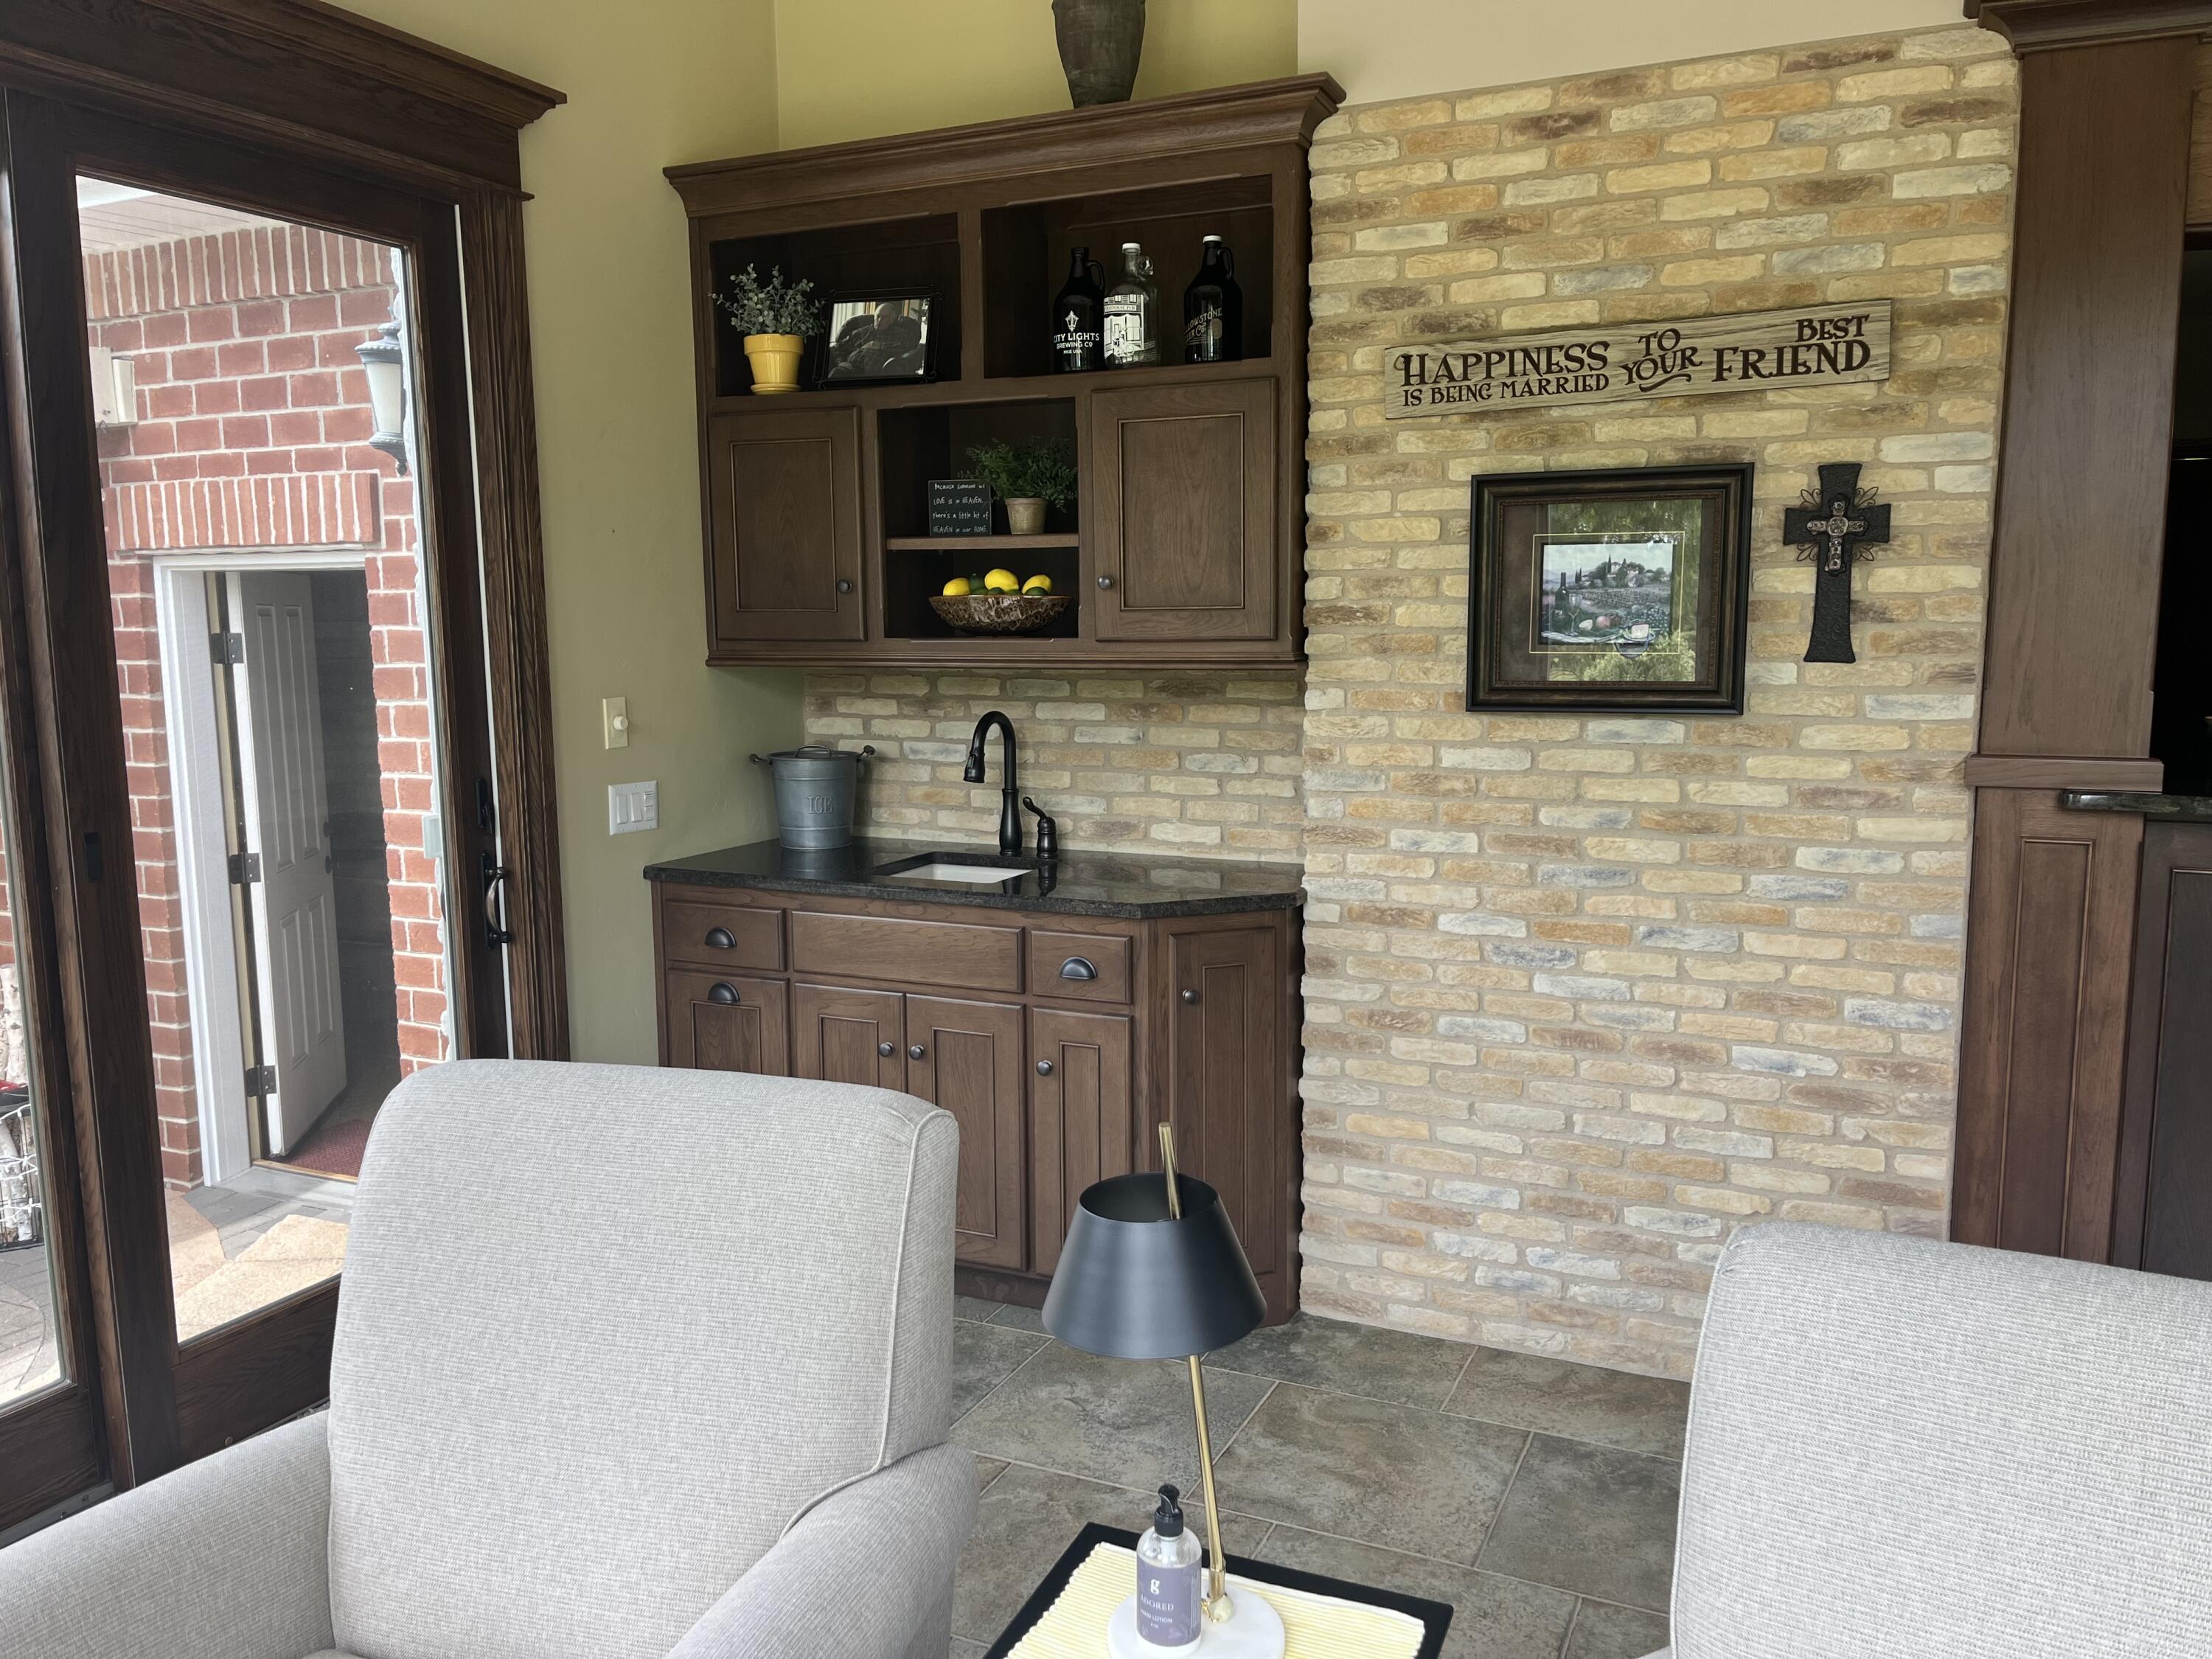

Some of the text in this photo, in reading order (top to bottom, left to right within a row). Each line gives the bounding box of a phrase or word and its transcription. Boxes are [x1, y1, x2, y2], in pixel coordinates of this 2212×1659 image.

[1795, 314, 1870, 342] BEST
[1068, 333, 1099, 341] LIGHTS
[1638, 327, 1681, 358] TO
[1394, 341, 1610, 386] HAPPINESS
[1618, 346, 1703, 386] YOUR
[1711, 339, 1871, 382] FRIEND
[1402, 374, 1610, 406] IS BEING MARRIED
[933, 496, 945, 505] LOVE
[933, 511, 950, 519] there's
[959, 511, 970, 519] little
[983, 511, 988, 520] of
[933, 525, 953, 533] HEAVEN
[807, 796, 832, 814] ICE
[1150, 1579, 1160, 1595] g
[1141, 1593, 1174, 1610] ADORED
[1152, 1615, 1172, 1623] LOTION
